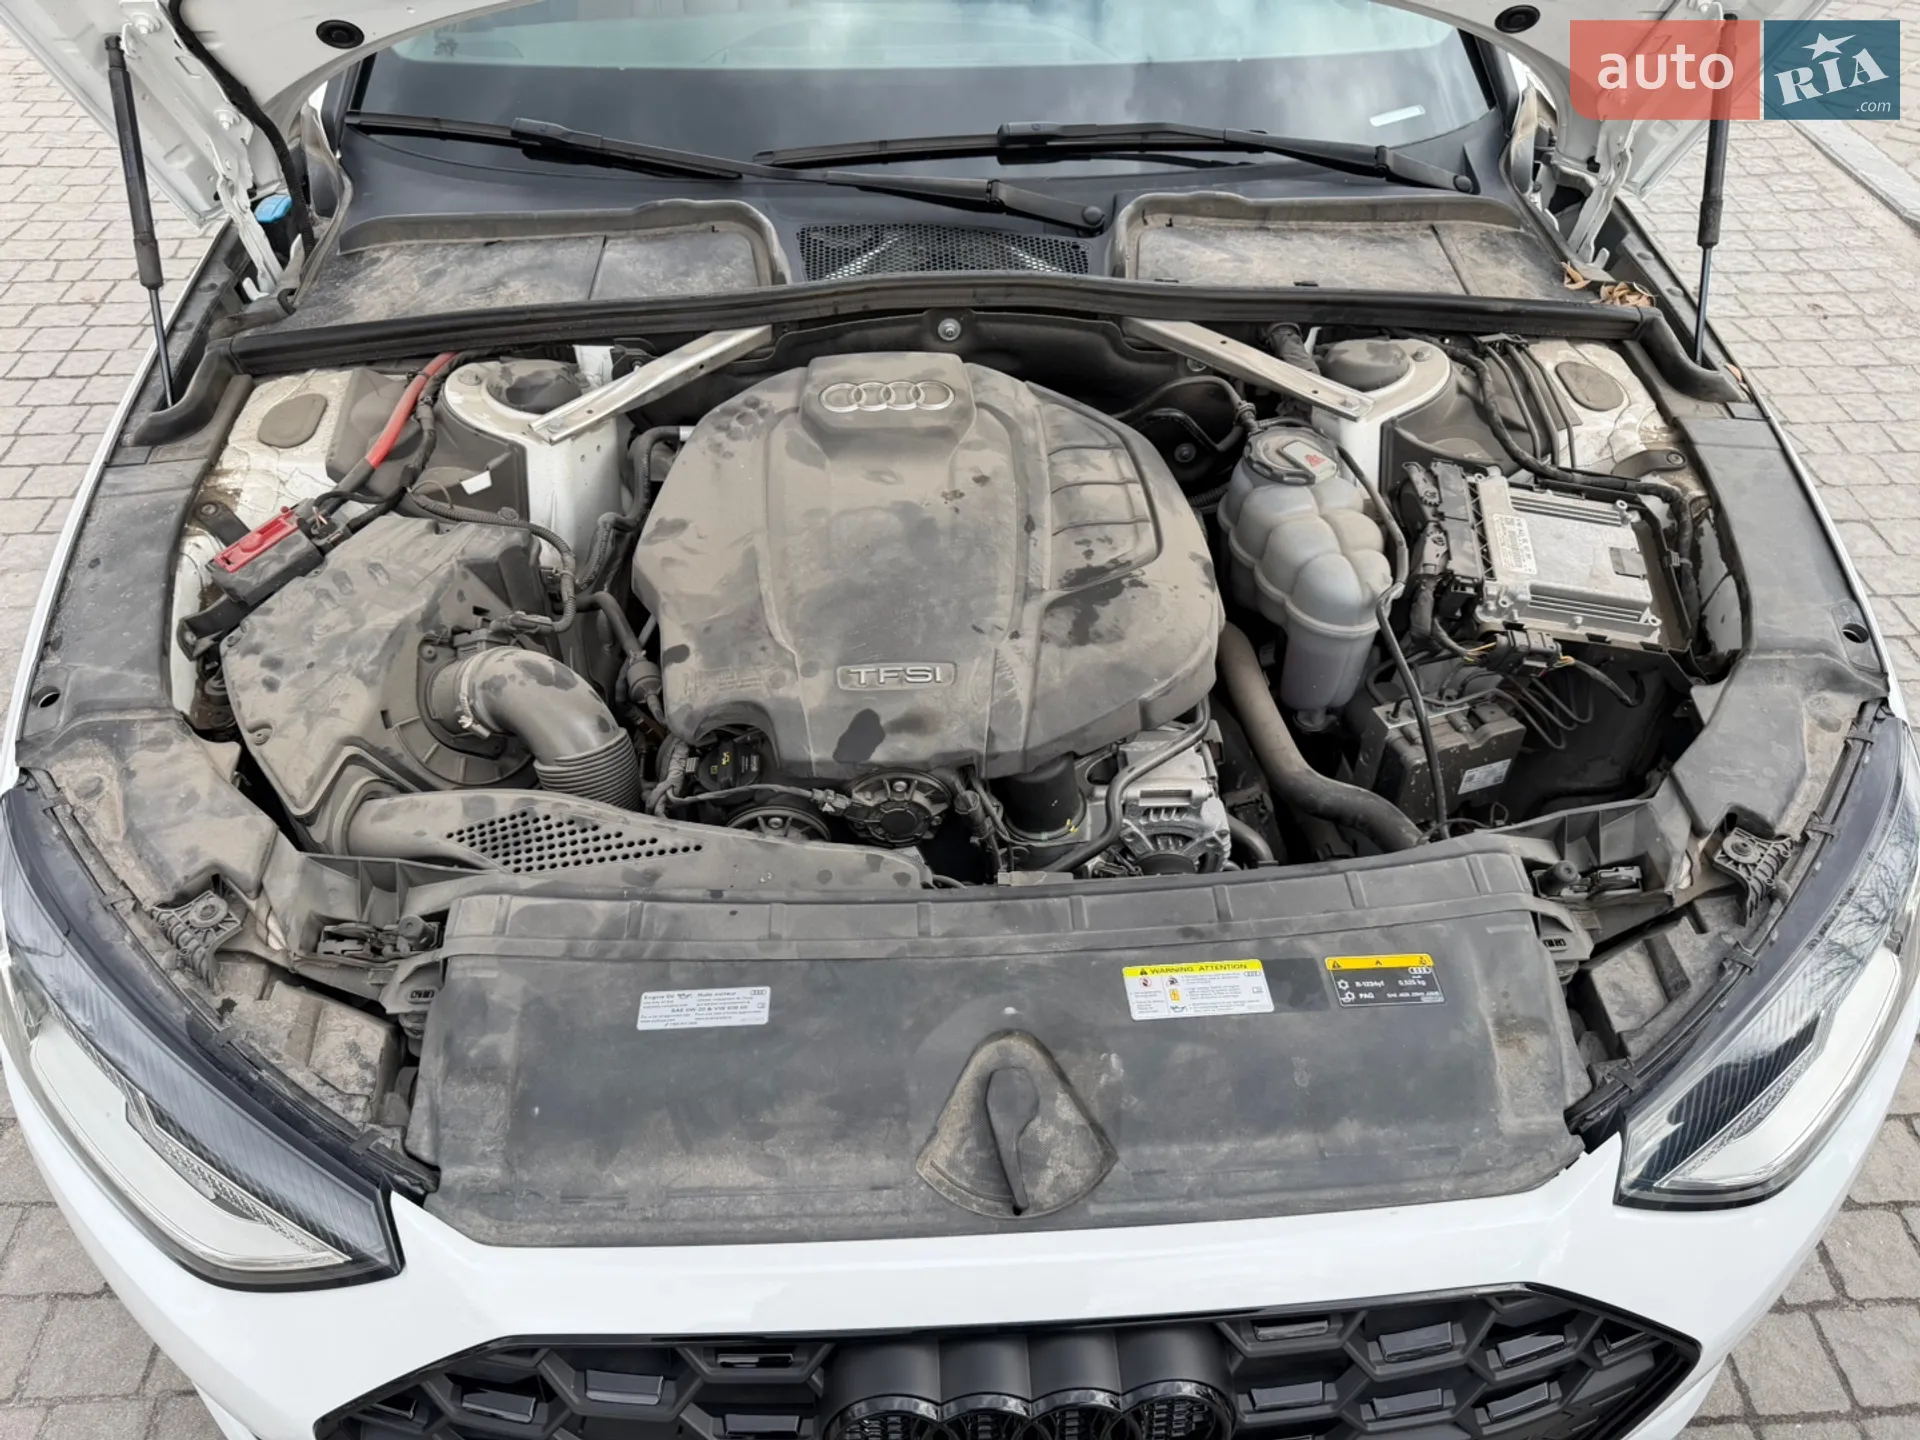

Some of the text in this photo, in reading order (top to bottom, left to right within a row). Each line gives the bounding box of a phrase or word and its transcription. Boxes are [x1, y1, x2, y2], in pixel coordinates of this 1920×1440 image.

[848, 666, 942, 685] TFSI
[1149, 963, 1248, 975] WARNING ATTENTION
